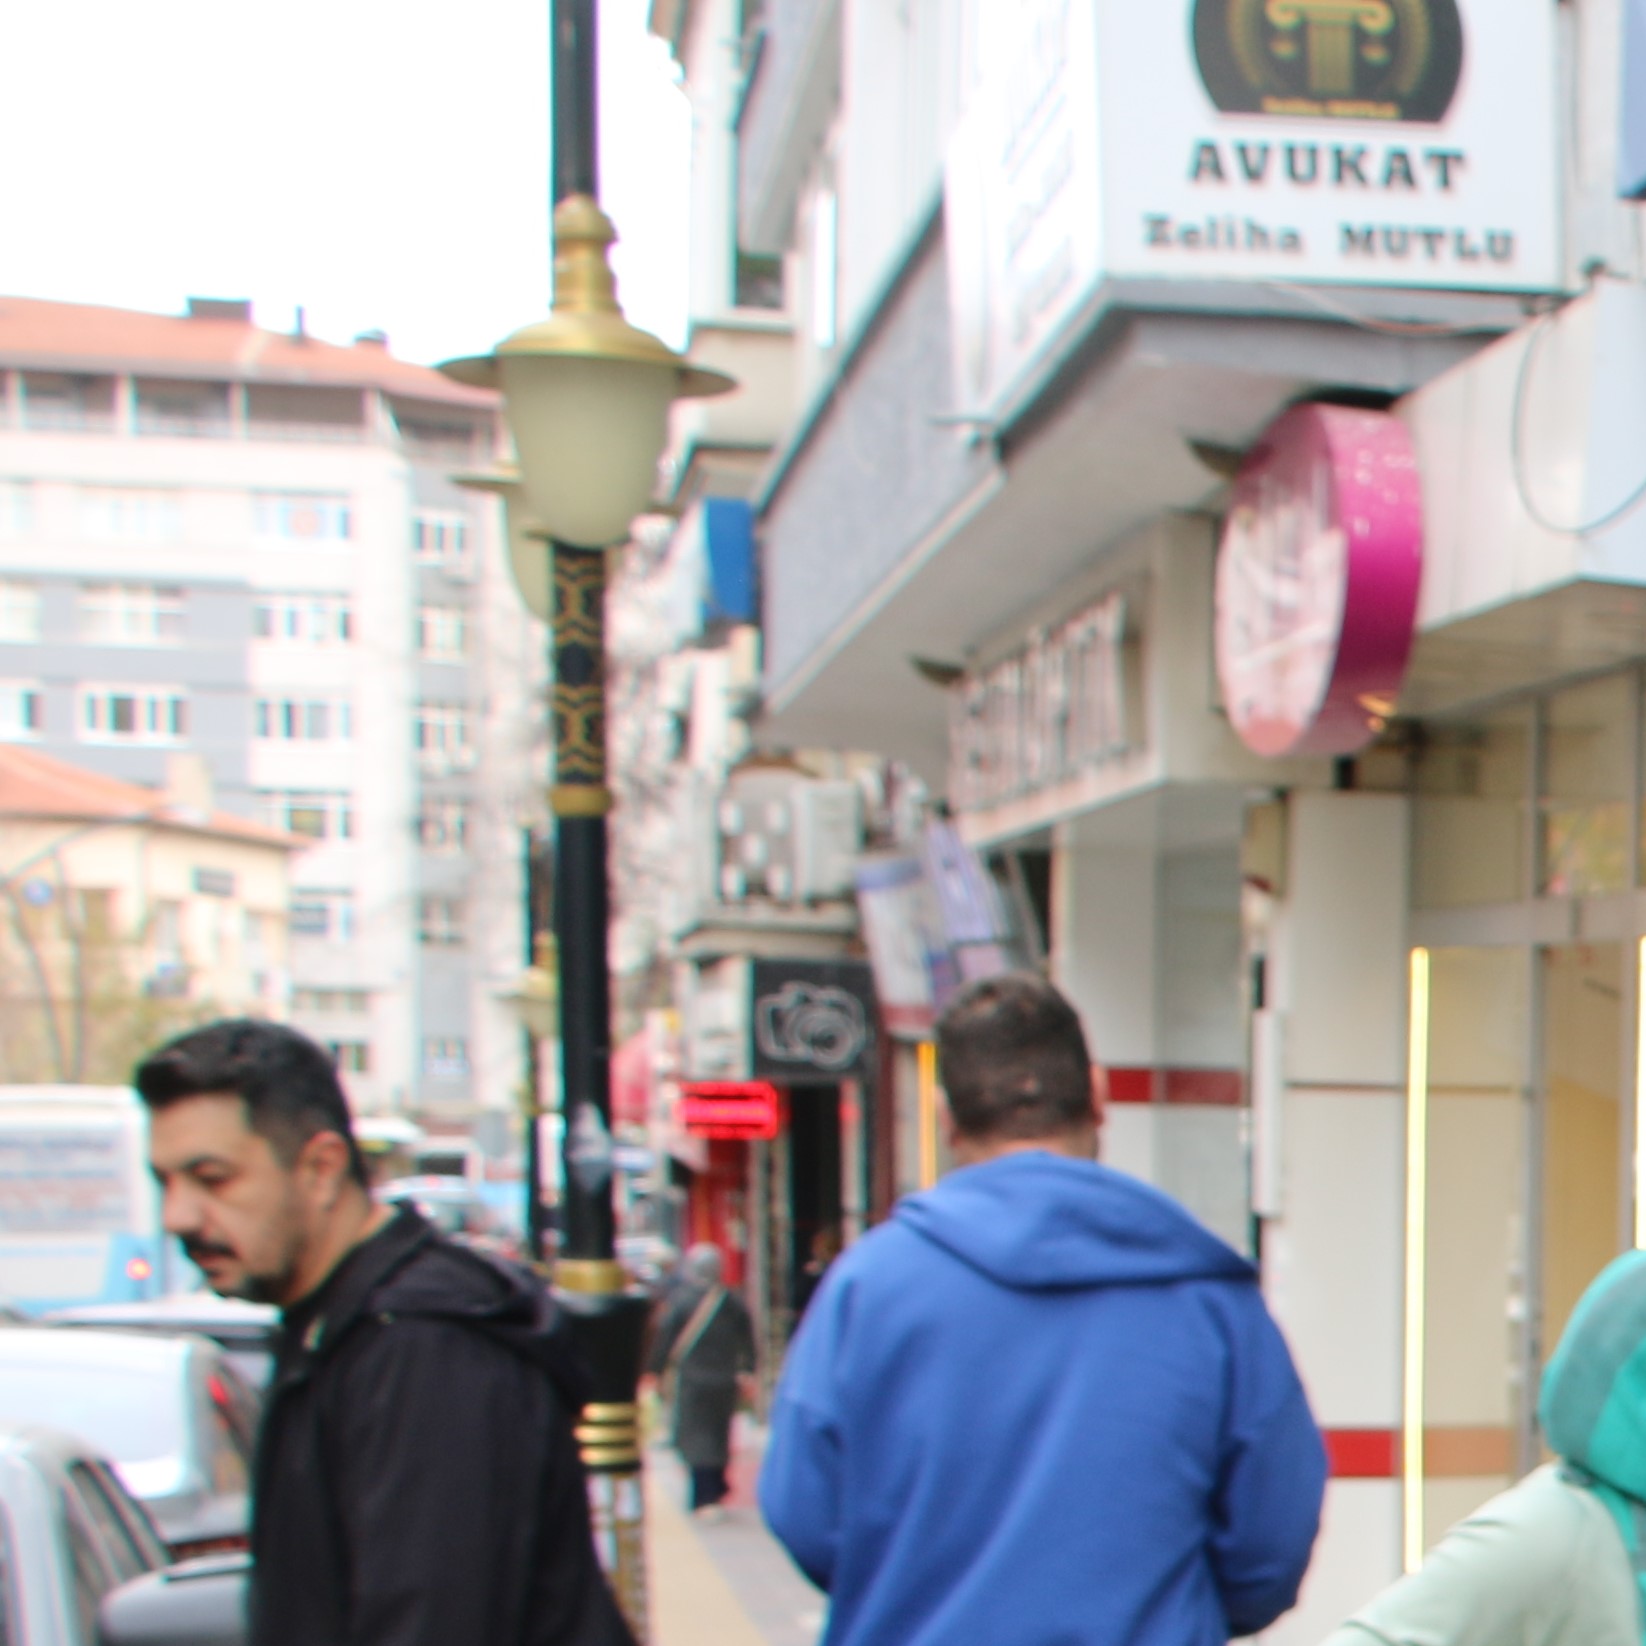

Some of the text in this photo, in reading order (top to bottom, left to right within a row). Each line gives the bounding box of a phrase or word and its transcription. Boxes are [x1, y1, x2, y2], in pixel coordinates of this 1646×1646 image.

[1189, 139, 1466, 191] AVUKAT
[1143, 213, 1515, 262] Zeliha MUTLU
